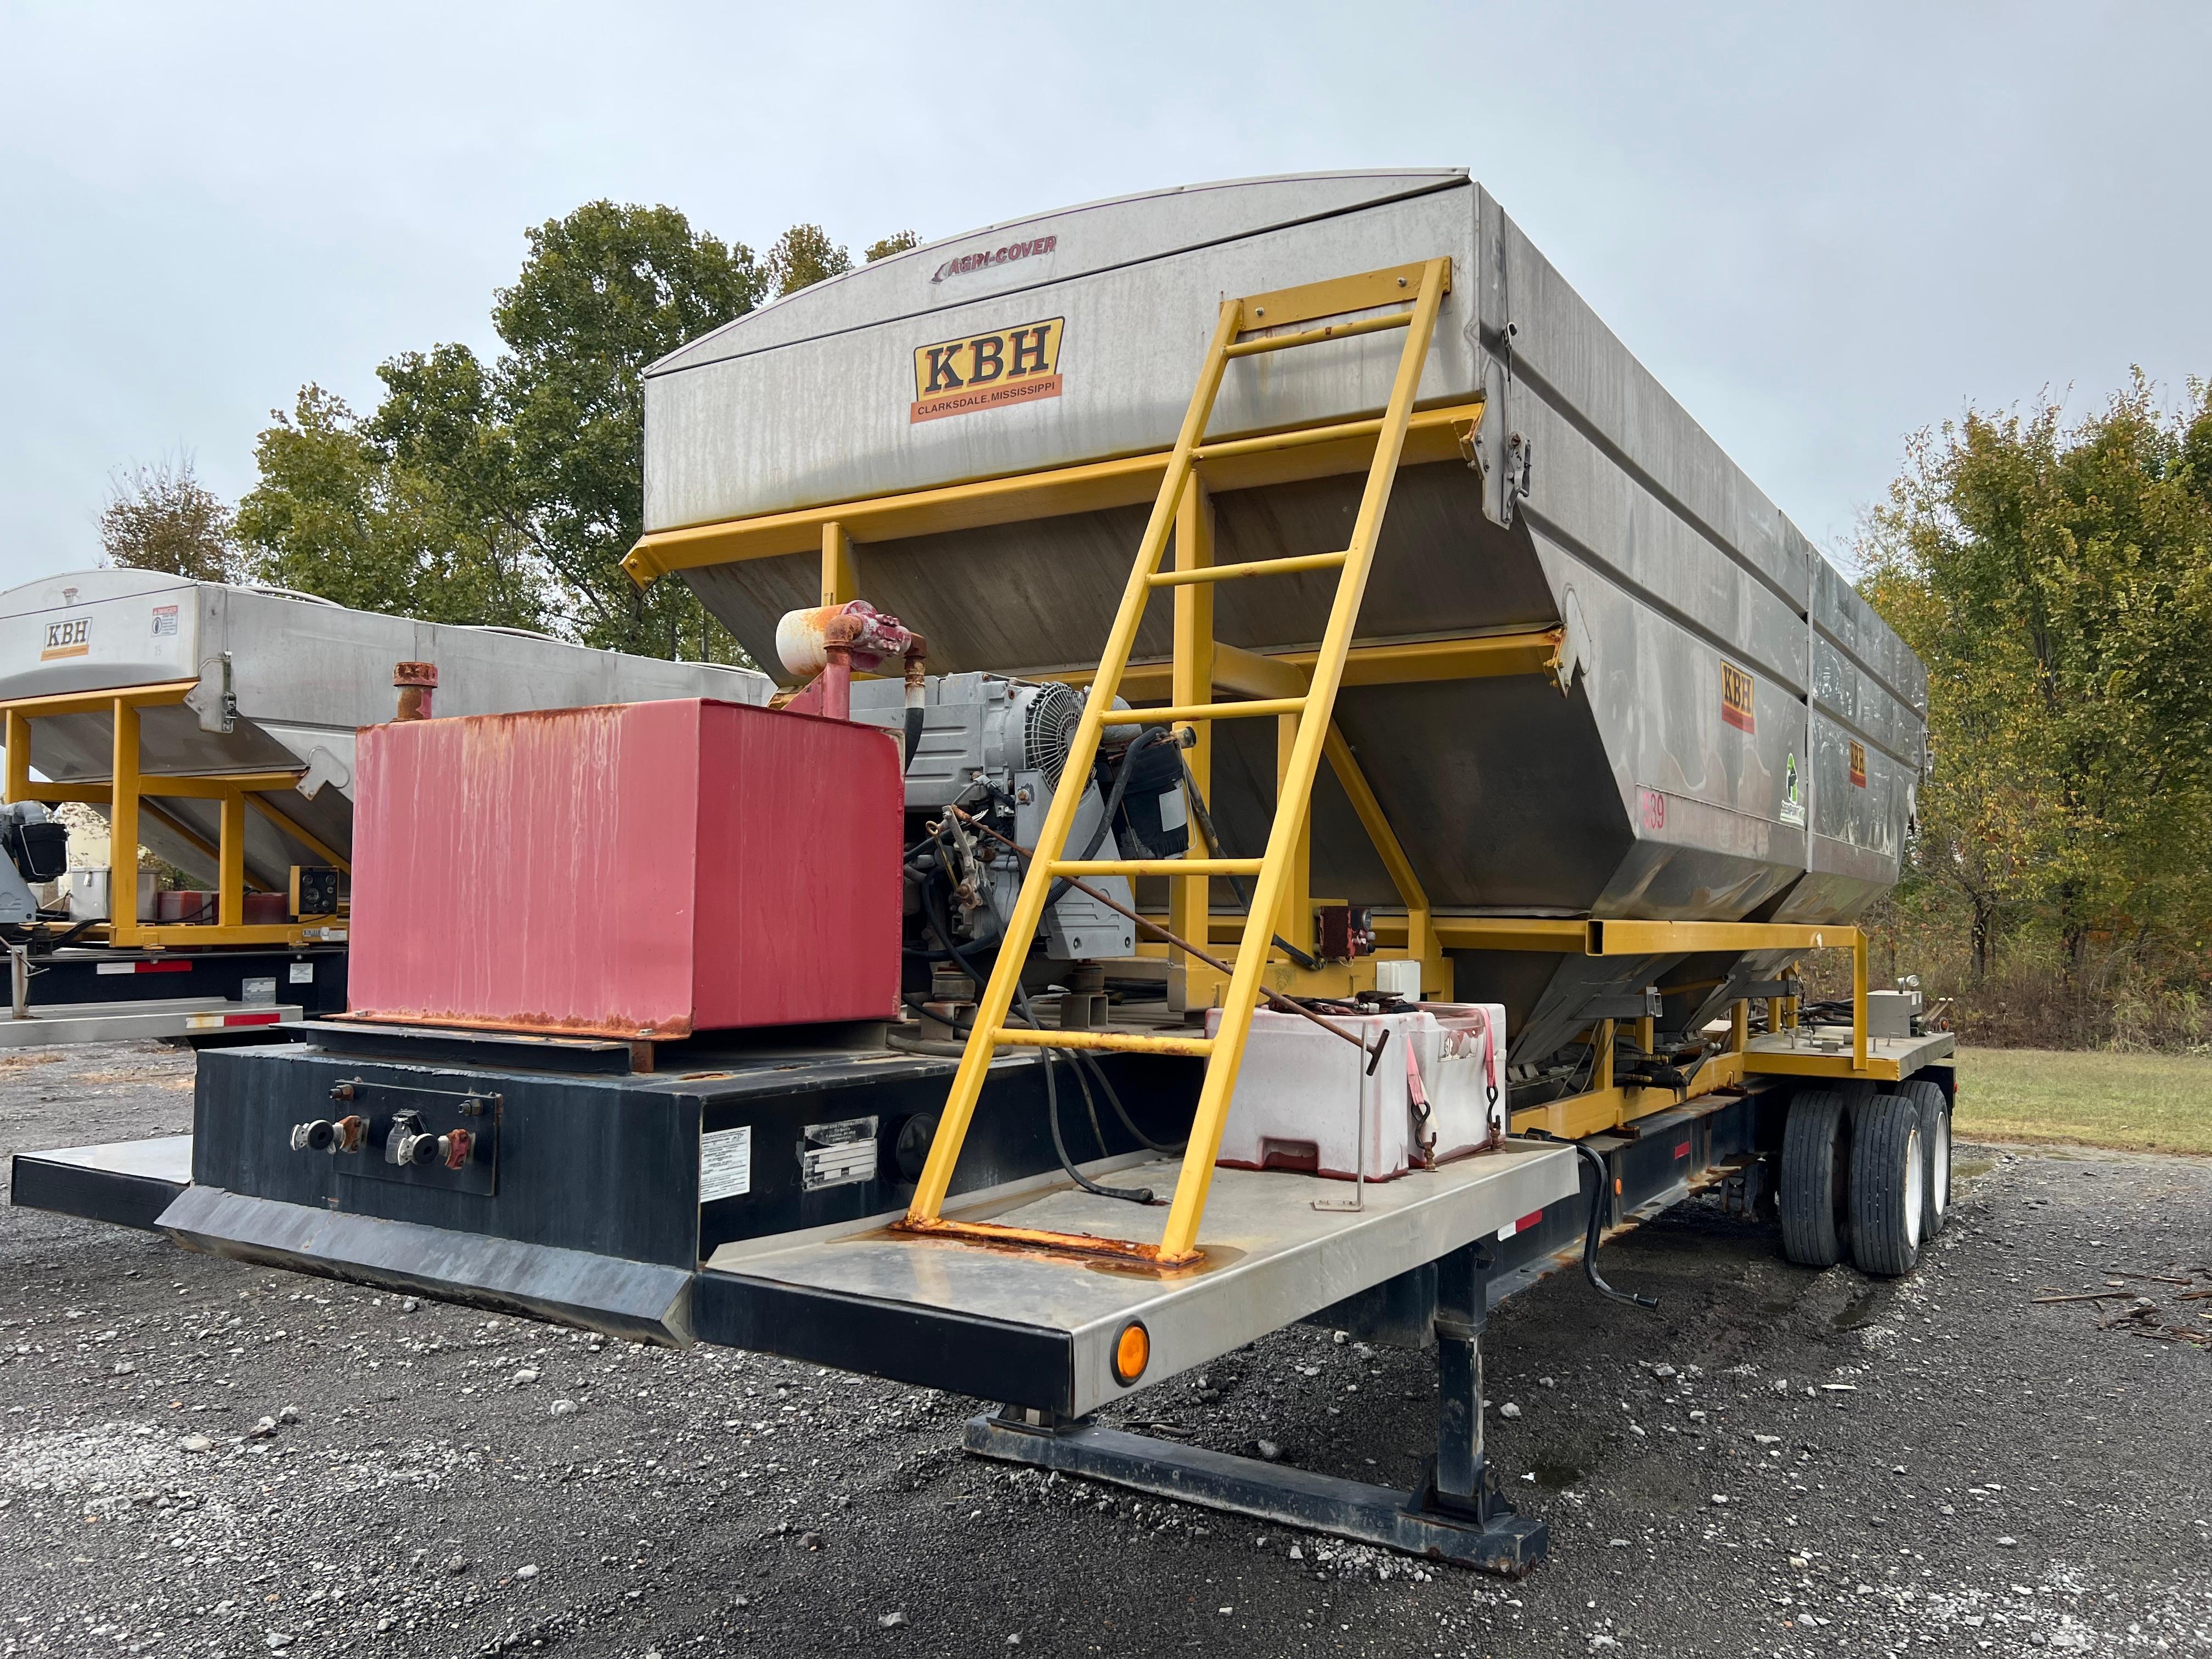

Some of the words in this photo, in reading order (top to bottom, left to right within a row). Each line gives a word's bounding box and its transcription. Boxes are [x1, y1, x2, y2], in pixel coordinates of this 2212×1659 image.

[950, 236, 1057, 274] AGRI-COVER
[924, 325, 1051, 394] KBH
[47, 620, 88, 647] KBH
[1723, 665, 1751, 714] KBH
[1850, 741, 1864, 773] KBH
